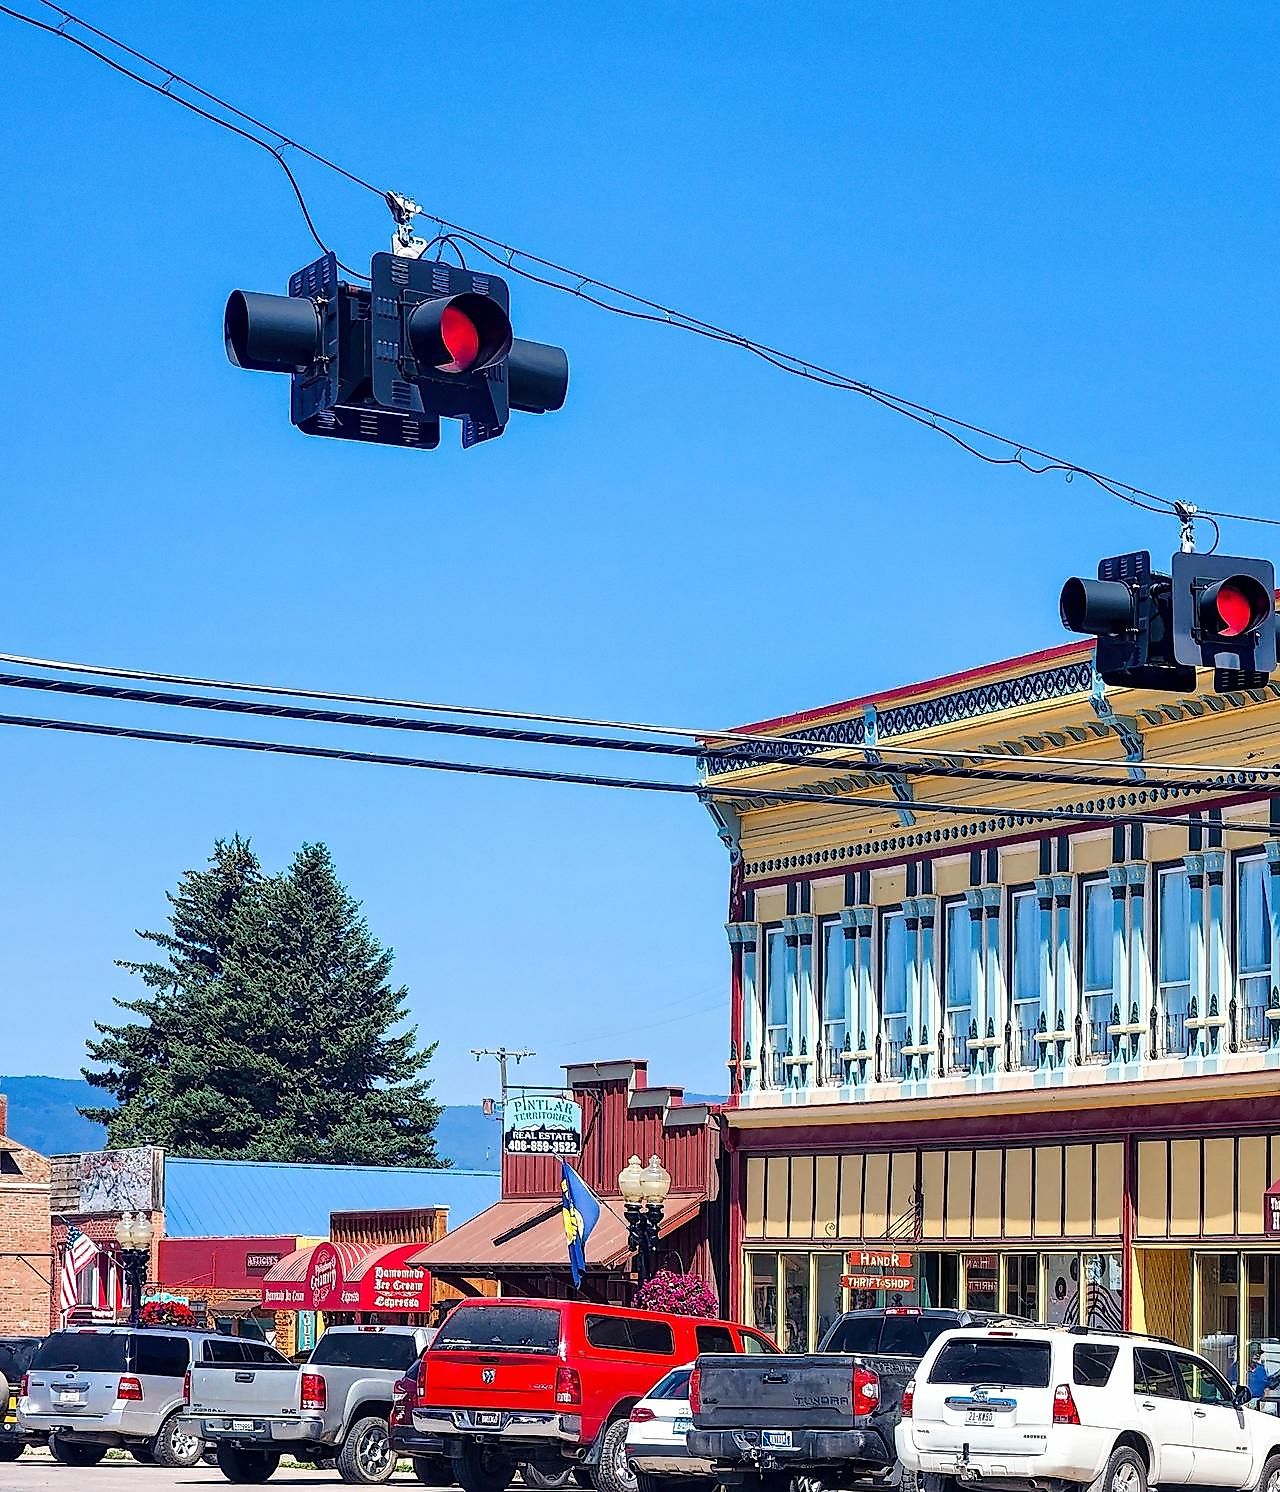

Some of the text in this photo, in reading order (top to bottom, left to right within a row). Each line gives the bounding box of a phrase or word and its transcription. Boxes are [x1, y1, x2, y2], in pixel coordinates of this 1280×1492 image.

[514, 1099, 574, 1115] PINTLAR
[514, 1112, 573, 1123] TERRITORIES
[512, 1131, 574, 1141] REAL ESTATE
[848, 1277, 910, 1289] THRIFT SHOP
[793, 1396, 850, 1407] TUNDRA
